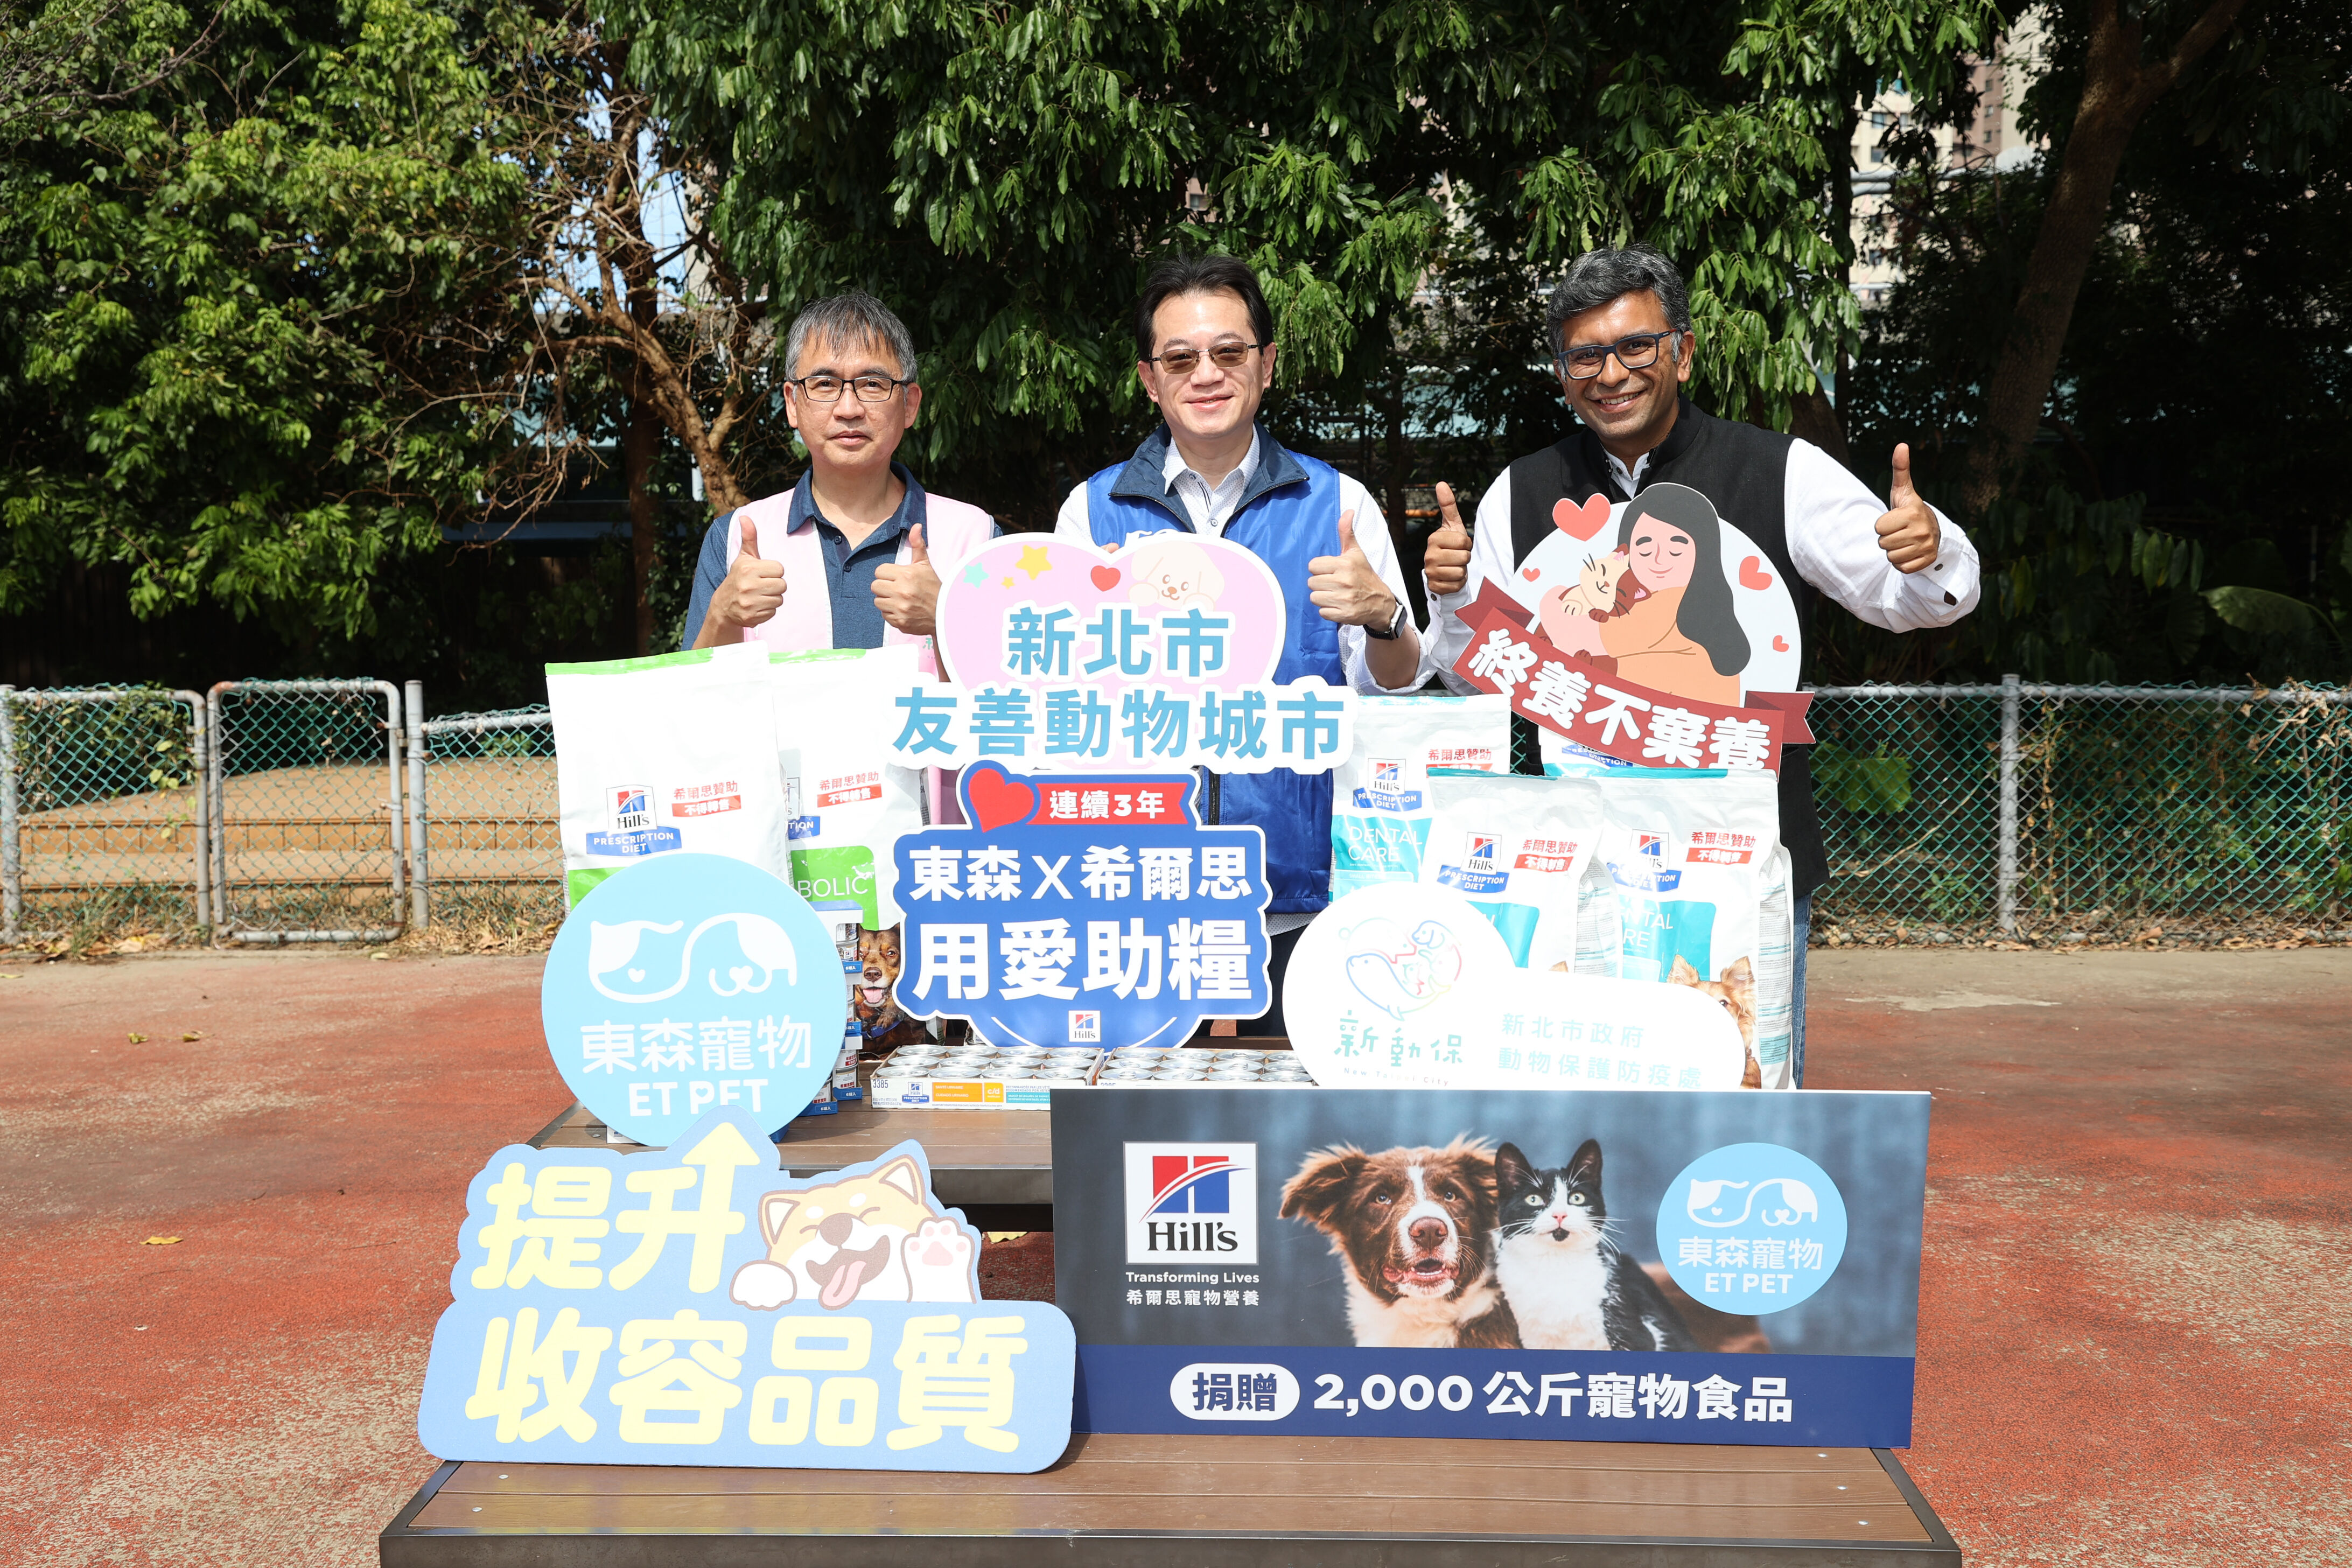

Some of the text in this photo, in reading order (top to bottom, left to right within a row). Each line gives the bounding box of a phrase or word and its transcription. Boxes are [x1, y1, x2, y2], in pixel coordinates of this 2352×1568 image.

[1007, 606, 1229, 677] 新北市
[1468, 628, 1770, 771] 終養不棄養
[893, 686, 1345, 760] 友善動物城市
[1374, 781, 1399, 792] Hill's
[1049, 789, 1165, 820] 連續3年
[1357, 793, 1417, 803] PRESCRIPTION
[1376, 801, 1396, 809] DIET
[617, 814, 649, 829] Hill's
[593, 832, 674, 845] PRESCRIPTION
[1349, 825, 1423, 845] DENTAL
[622, 843, 647, 853] DIET
[1348, 846, 1400, 863] CARE
[1468, 859, 1494, 871] Hill's
[1444, 869, 1504, 884] PRESCRIPTION
[1464, 881, 1485, 891] DIET
[912, 917, 1252, 1002] 用愛助糧
[1074, 1031, 1096, 1039] Hill's
[1333, 1010, 1463, 1067] 新動保
[1501, 1012, 1644, 1048] 新北市政府
[580, 1014, 810, 1075] 東森寵物
[1344, 1068, 1367, 1076] New
[1423, 1076, 1448, 1087] City
[1497, 1047, 1702, 1089] 動物保護防疫處
[873, 1079, 888, 1088] 3385
[628, 1079, 768, 1117] ET PET
[470, 1122, 760, 1293] 提升
[1145, 1221, 1238, 1252] Hill's
[1678, 1235, 1824, 1270] 東森寵物
[1125, 1271, 1259, 1285] Transforming Lives
[1705, 1272, 1794, 1294] ET PET
[1126, 1289, 1259, 1306] 希爾思寵物營養
[465, 1307, 1028, 1453] 收容品質
[1192, 1372, 1277, 1412] 捐贈
